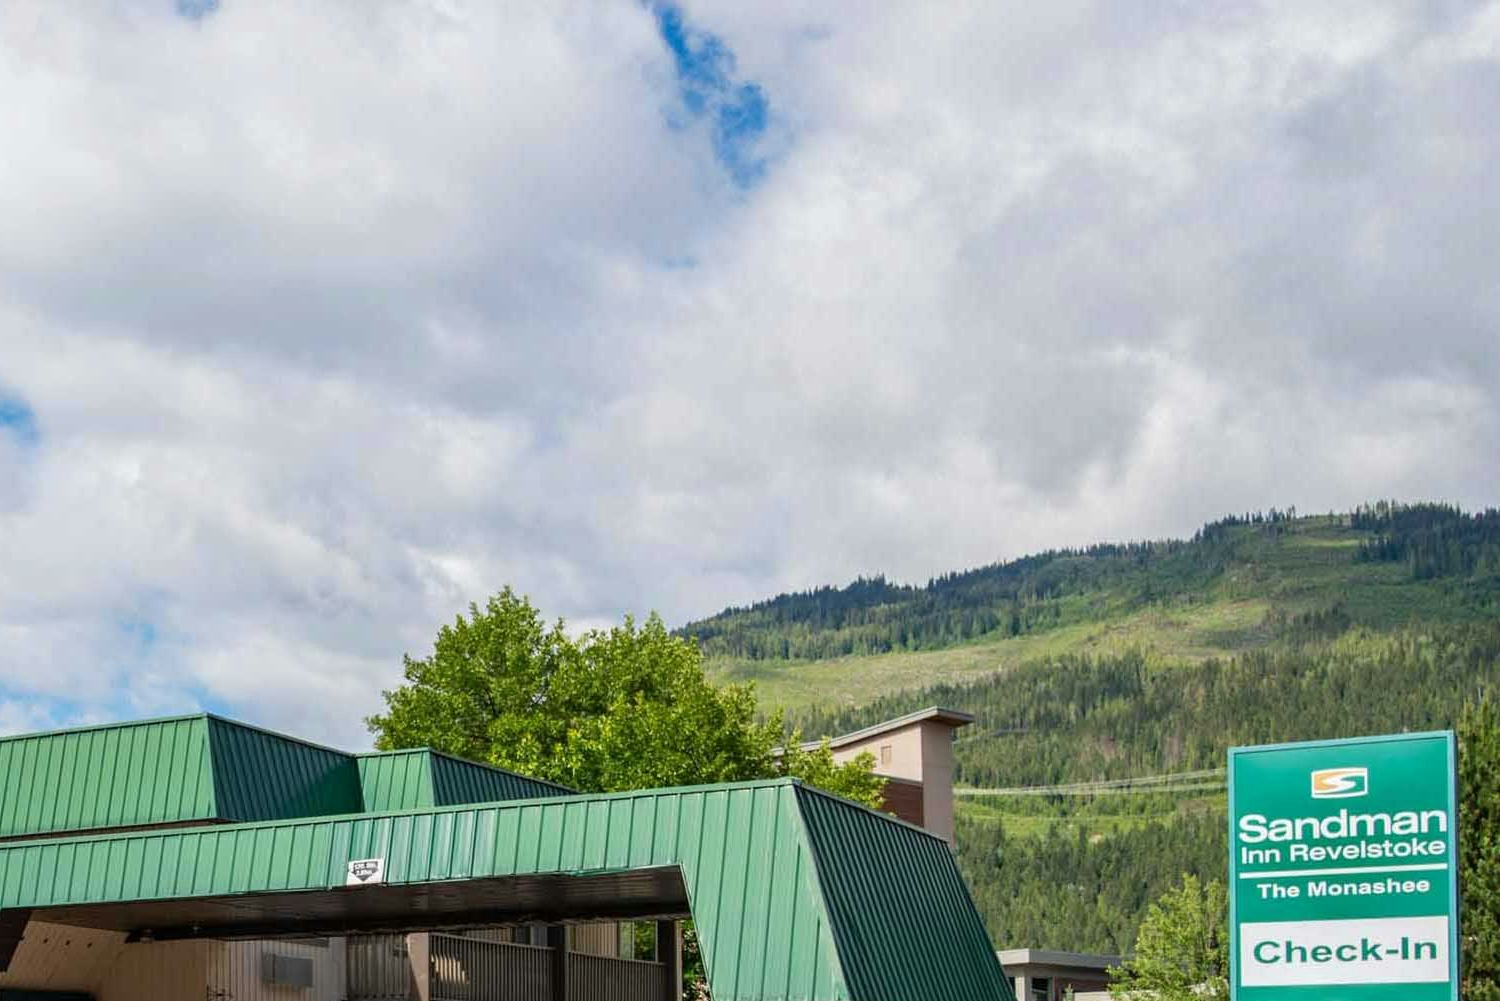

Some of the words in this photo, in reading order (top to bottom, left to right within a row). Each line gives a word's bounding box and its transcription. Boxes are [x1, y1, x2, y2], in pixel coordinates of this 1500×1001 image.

[1239, 808, 1448, 843] Sandman
[1241, 847, 1281, 864] Inn
[1290, 838, 1446, 862] Revelstoke
[1257, 883, 1300, 899] The
[1308, 877, 1430, 897] Monashee
[1253, 936, 1438, 964] Check-In
